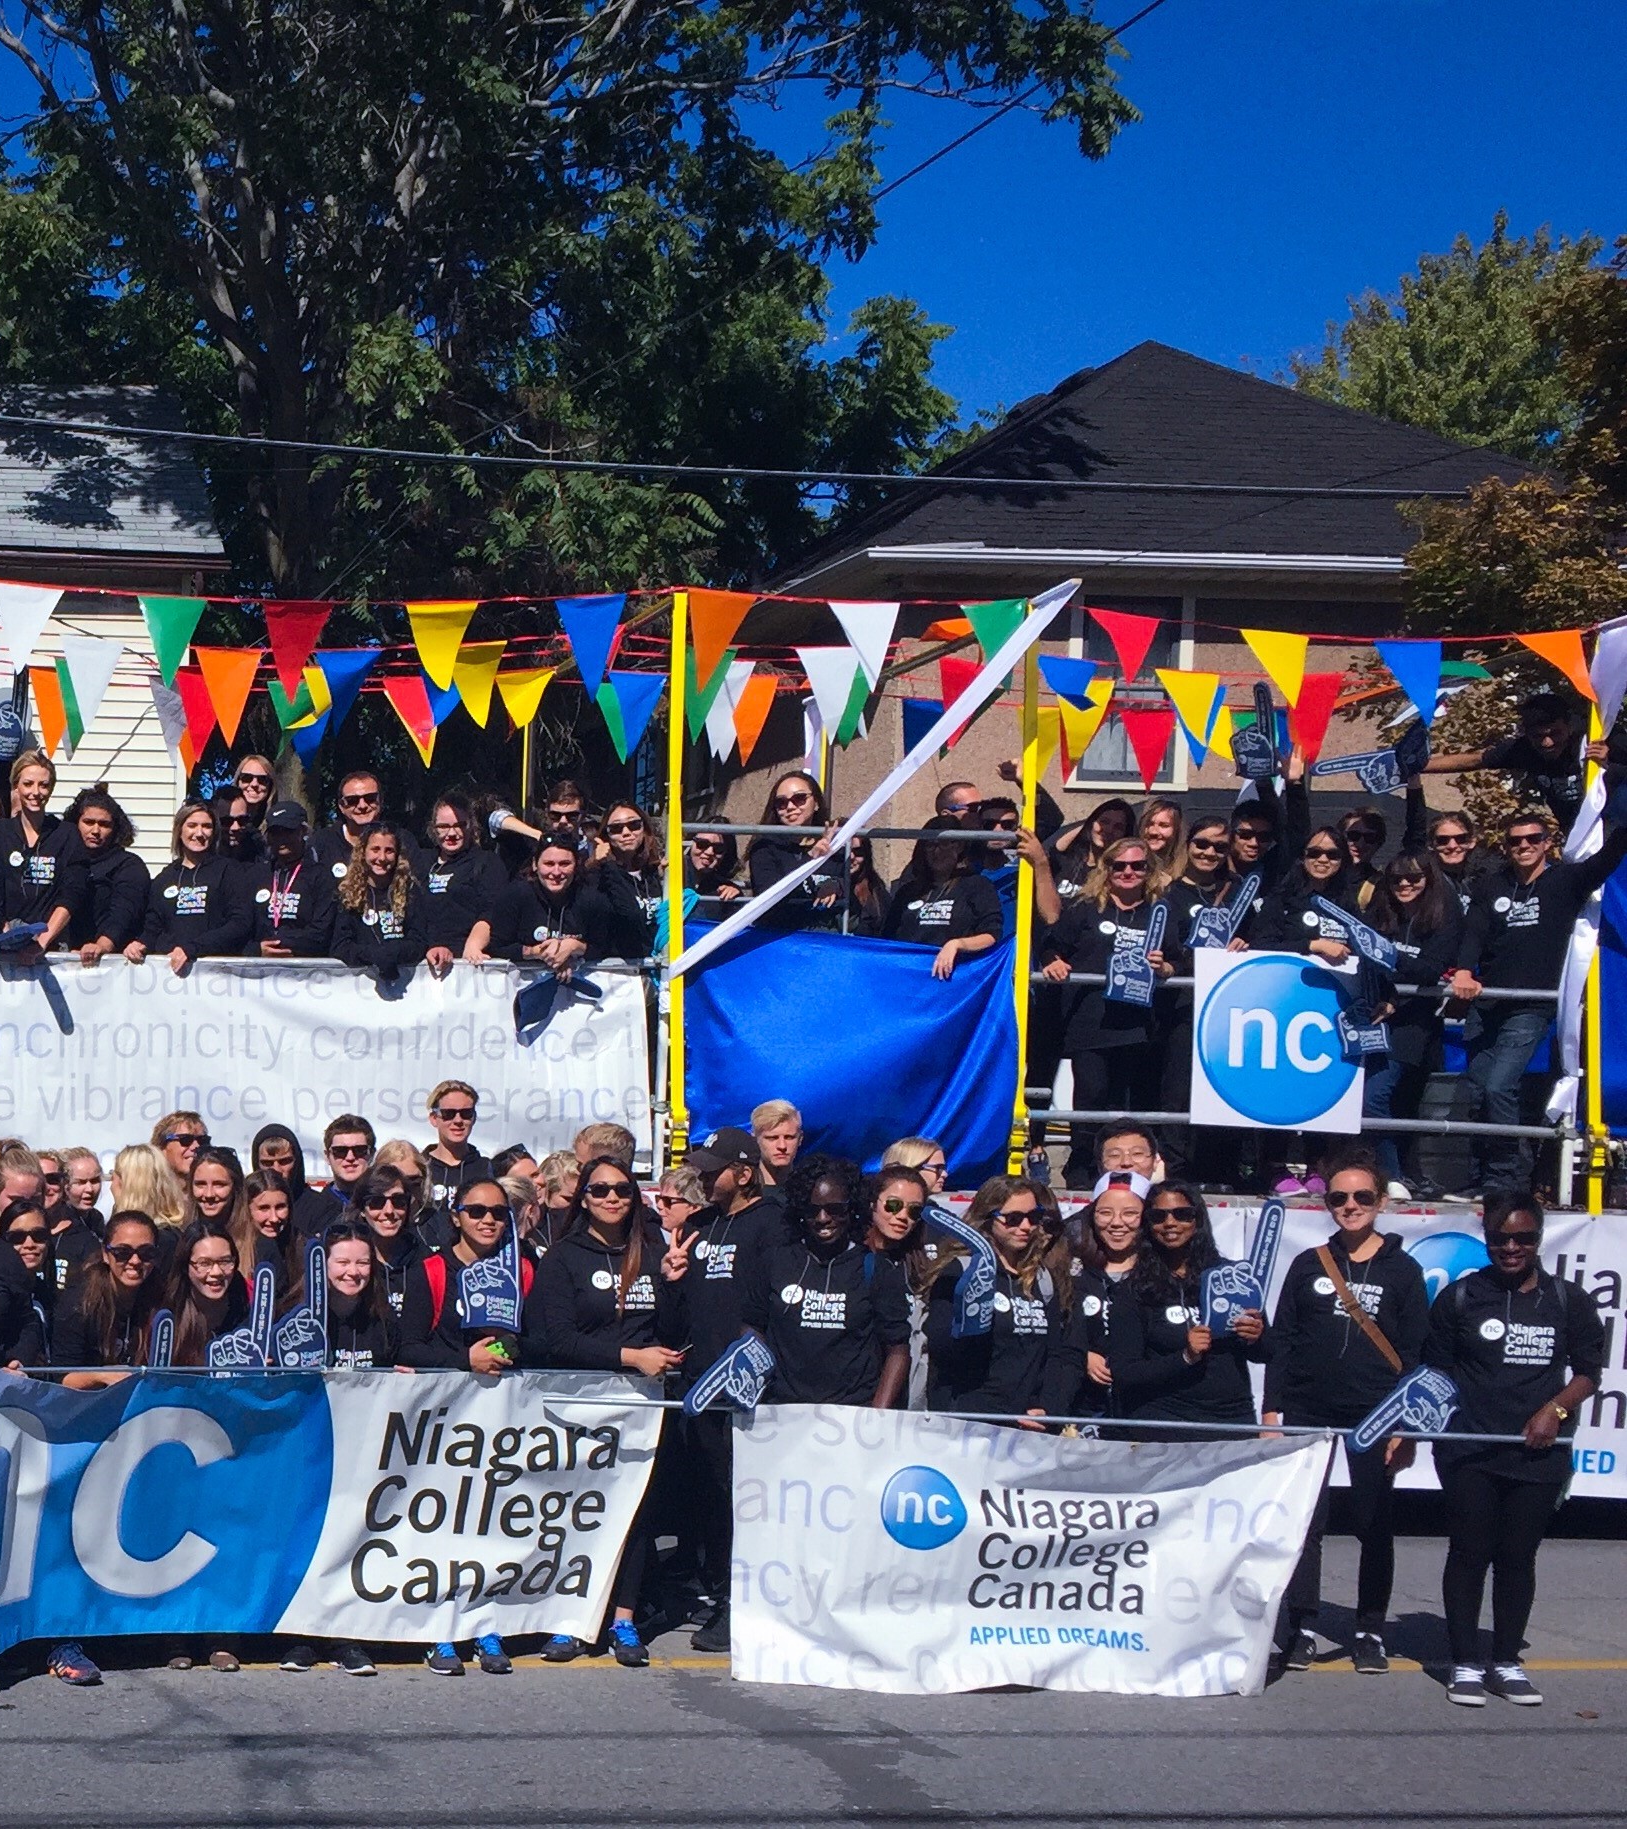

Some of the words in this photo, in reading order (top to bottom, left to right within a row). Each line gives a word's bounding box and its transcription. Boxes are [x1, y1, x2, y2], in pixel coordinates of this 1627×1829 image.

[1227, 1006, 1335, 1074] nc
[40, 1072, 267, 1123] vibrance
[292, 1076, 648, 1136] perseerance
[1257, 1229, 1273, 1277] KNIGHTS
[594, 1276, 609, 1284] nc
[1318, 1280, 1333, 1288] nc
[802, 1299, 846, 1312] College
[805, 1289, 846, 1302] Niagara
[1086, 1301, 1098, 1309] nc
[256, 1293, 268, 1341] KNIGHTS
[801, 1308, 846, 1321] Canada
[1170, 1309, 1185, 1318] nc
[1485, 1324, 1501, 1333] nc
[1508, 1324, 1555, 1338] Niagara
[1504, 1344, 1554, 1357] Canada
[1506, 1334, 1555, 1348] College
[335, 1348, 373, 1360] Niagara
[380, 1408, 619, 1487] Niagara
[364, 1473, 607, 1550] College
[896, 1491, 954, 1526] nc
[979, 1488, 1160, 1538] Niagara
[976, 1531, 1150, 1575] College
[351, 1537, 591, 1604] Canada
[967, 1572, 1144, 1615] Canada
[969, 1626, 1051, 1646] APPLIED
[1058, 1626, 1151, 1652] DREAMS.
